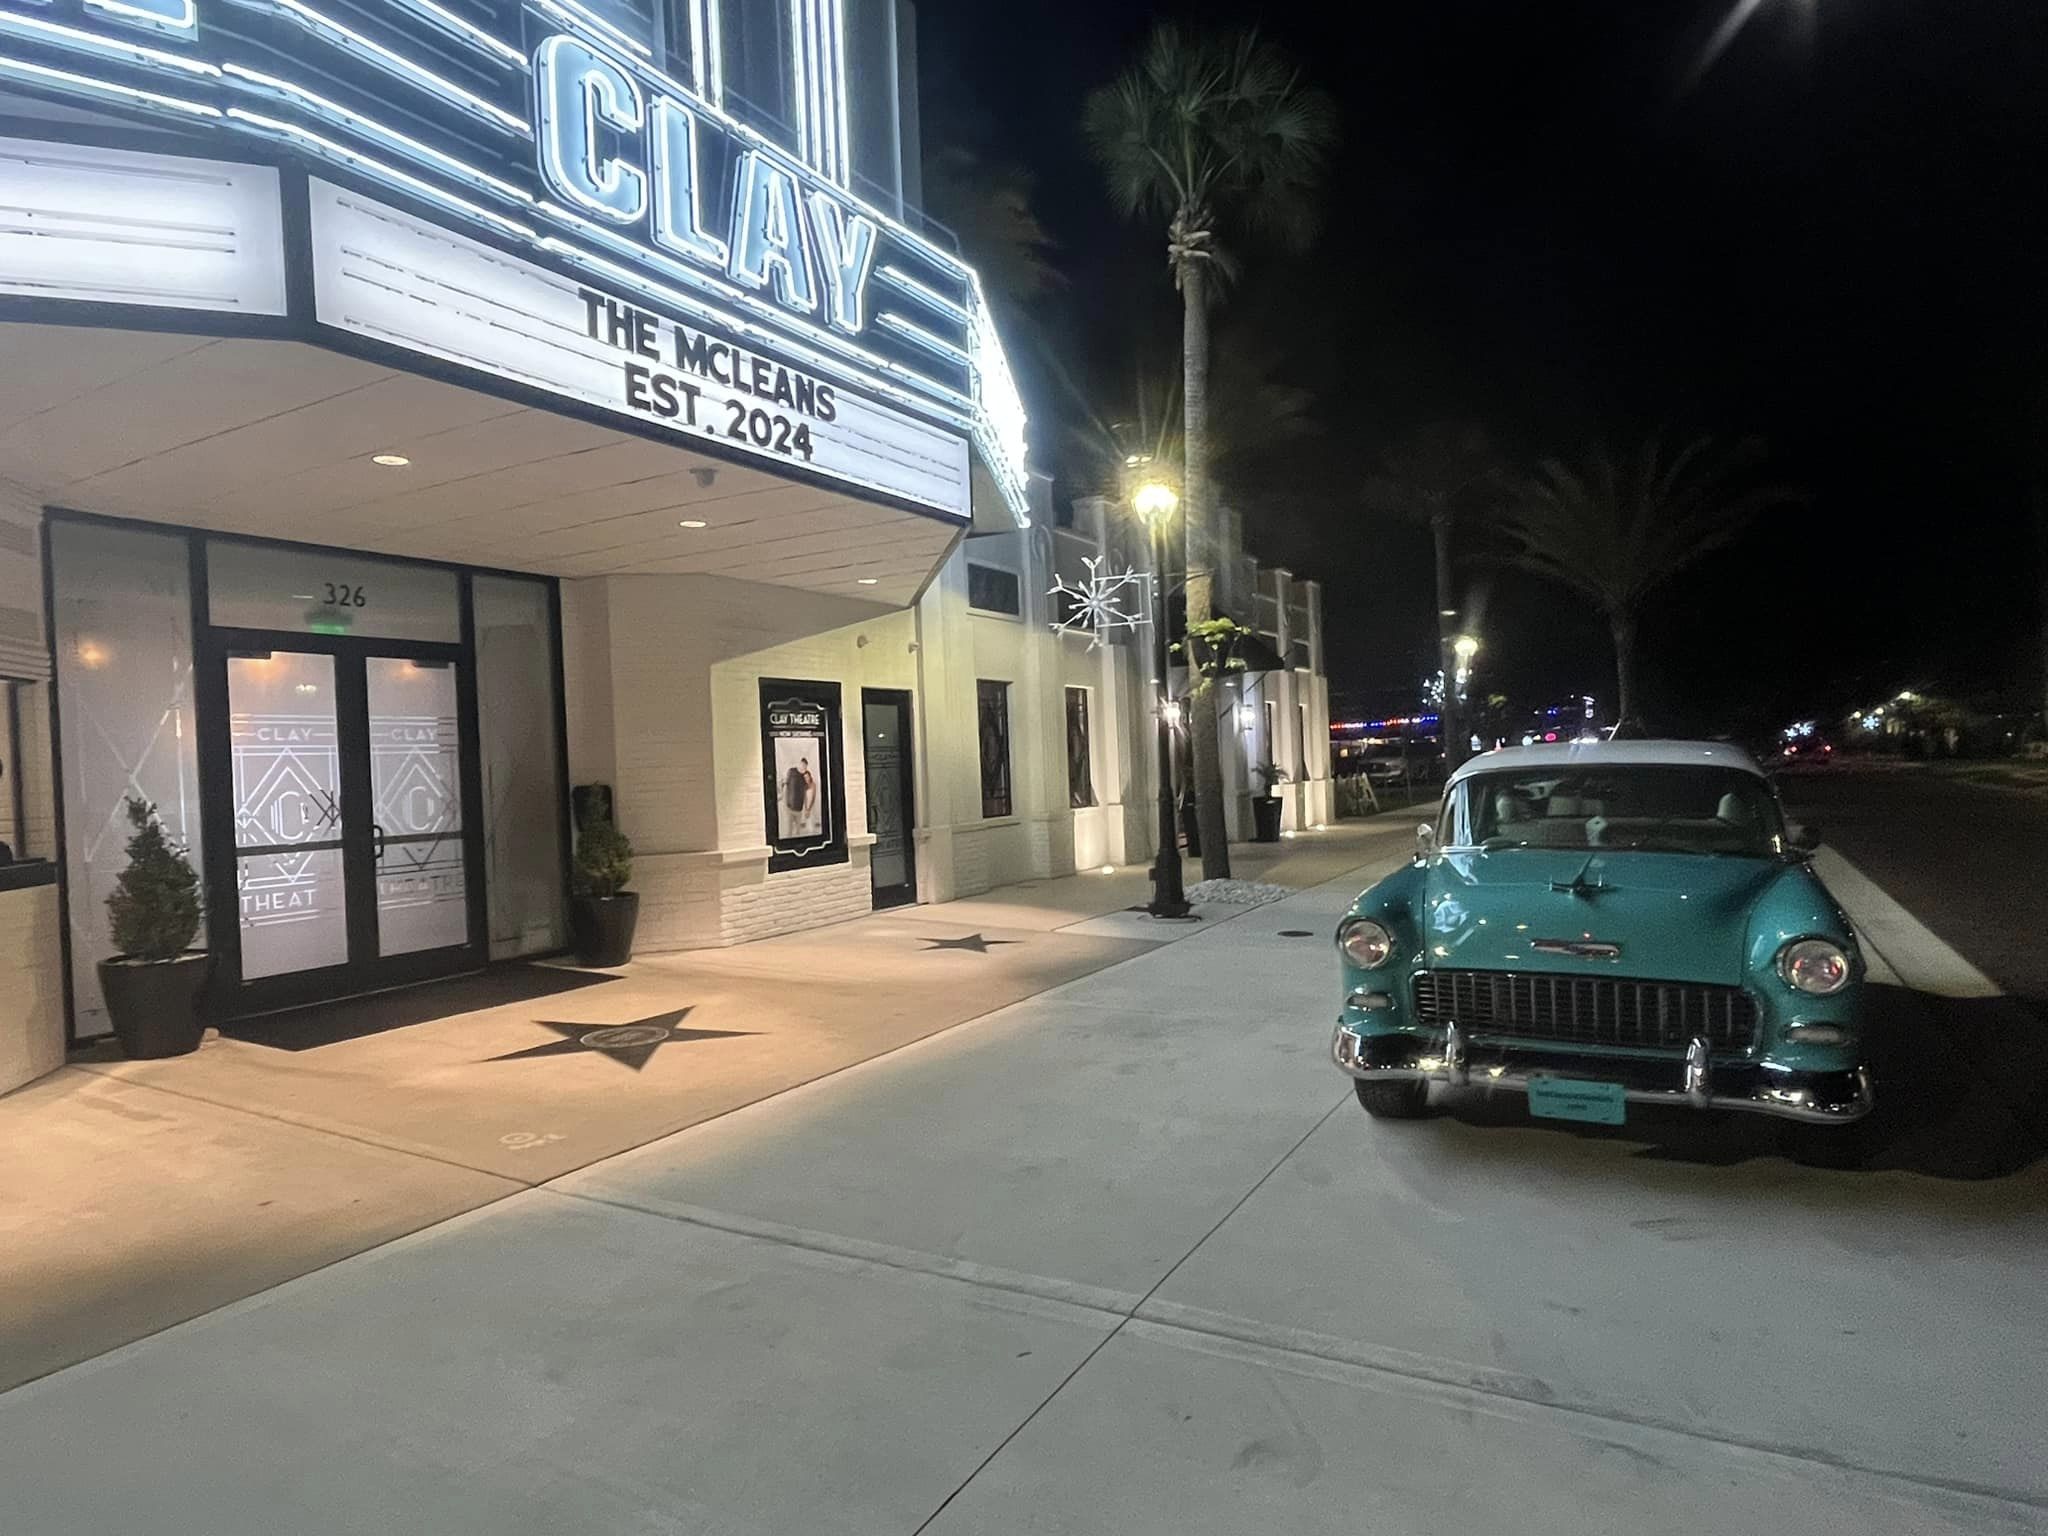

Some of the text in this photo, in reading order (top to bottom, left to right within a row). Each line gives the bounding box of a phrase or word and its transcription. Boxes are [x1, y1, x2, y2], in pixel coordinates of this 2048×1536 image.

[533, 34, 877, 336] CLAY
[578, 286, 838, 422] THE MCLEANS
[726, 399, 815, 462] 2024
[323, 582, 366, 607] 326
[770, 713, 820, 725] CLAY THEATRE
[256, 727, 313, 741] CLAY
[391, 727, 438, 741] CLAY
